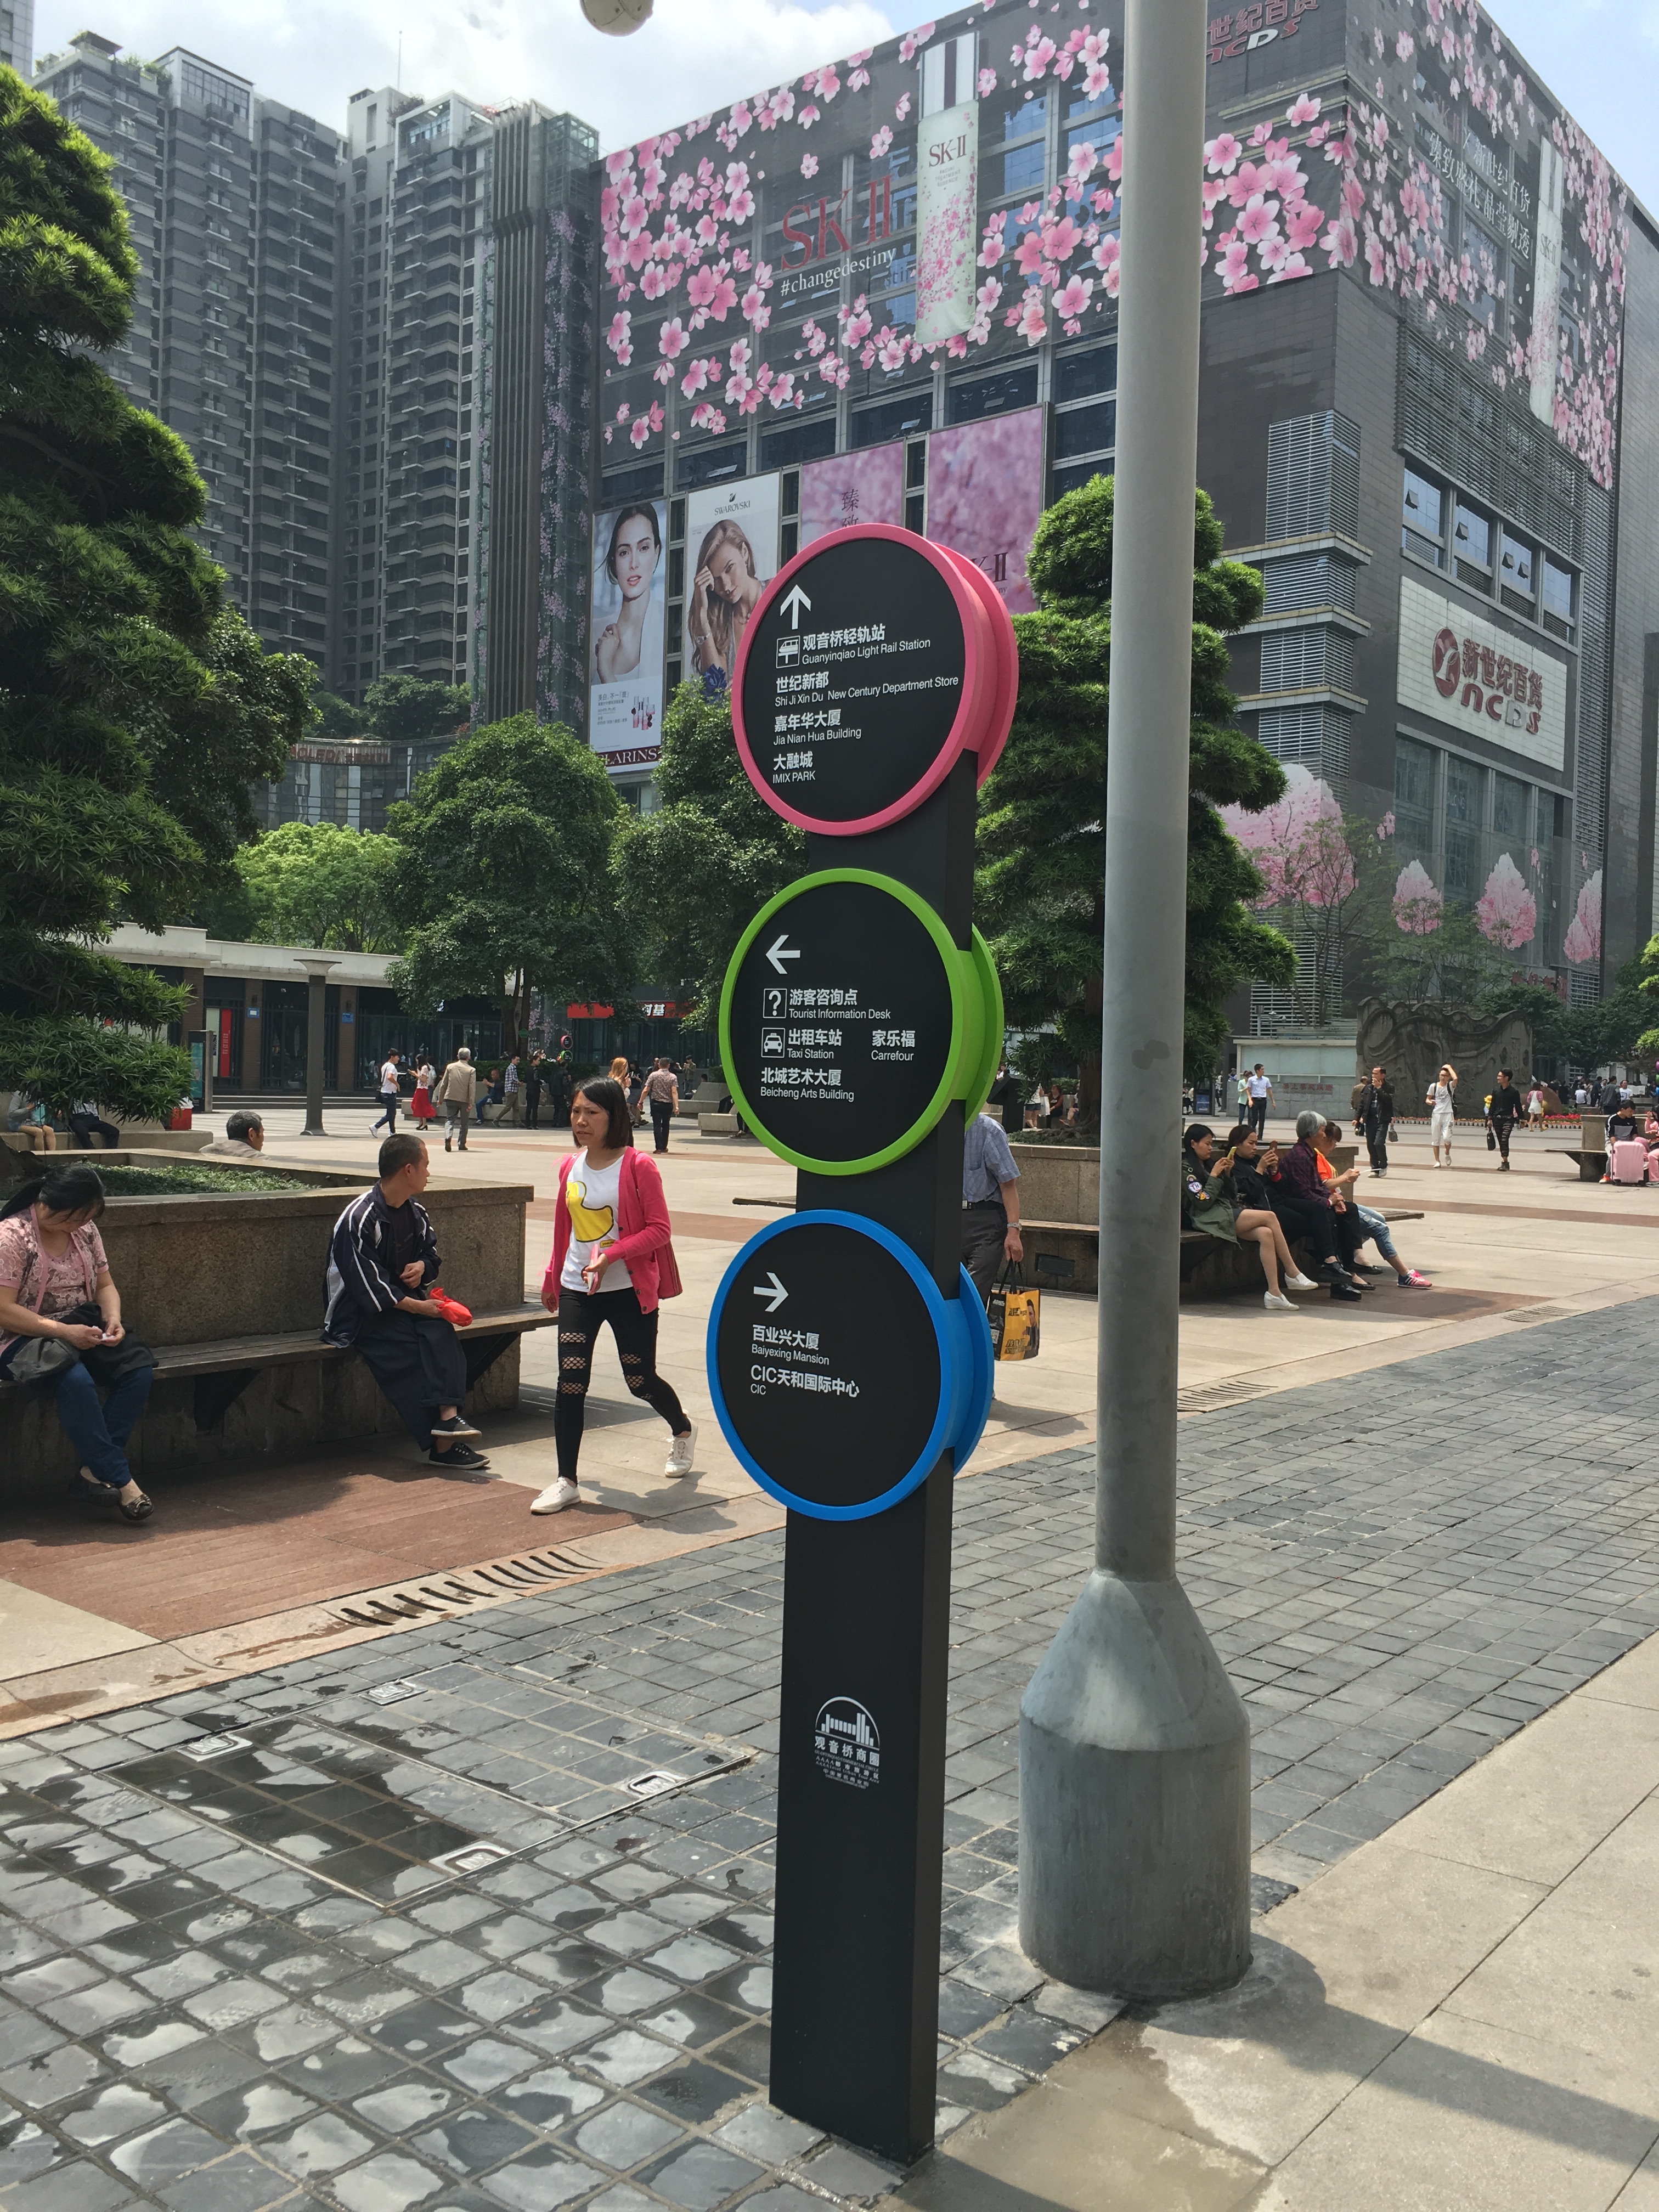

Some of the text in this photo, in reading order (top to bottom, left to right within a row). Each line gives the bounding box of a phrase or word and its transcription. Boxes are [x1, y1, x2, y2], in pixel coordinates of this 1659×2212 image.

[929, 134, 967, 167] SK-II
[781, 173, 893, 272] SK-II
[781, 247, 897, 297] #changedestiny
[714, 500, 751, 516] SWAROVSKI
[803, 623, 885, 651] 观音桥轻轨站
[802, 639, 930, 664] Guanyinqiao Light Rail Station
[776, 672, 829, 693] 世纪新都
[1462, 638, 1543, 710] 新世纪百货
[775, 677, 958, 707] Shi Ji Xin Du New Century Department Store
[775, 709, 841, 732] 嘉年华大厦
[774, 728, 861, 745] Jia Nian Hua Building
[774, 751, 812, 770] 大融城
[773, 770, 815, 783] IMIX PARK
[790, 989, 857, 1005] 游客咨询点
[789, 1009, 890, 1019] Tourist Information Desk
[788, 1029, 842, 1046] 出租车站
[872, 1030, 915, 1047] 家乐福
[787, 1048, 833, 1058] Taxi Station
[872, 1050, 913, 1060] Carrefour
[761, 1067, 842, 1086] 北城艺术大厦
[761, 1087, 854, 1102] Beicheng Arts Building
[753, 1324, 819, 1350] 百业兴大厦
[752, 1344, 829, 1365] Baiyexing Mansion
[751, 1365, 859, 1397] CIC天和国际中心
[751, 1384, 766, 1395] CIC
[815, 1736, 879, 1767] 观音桥商圈
